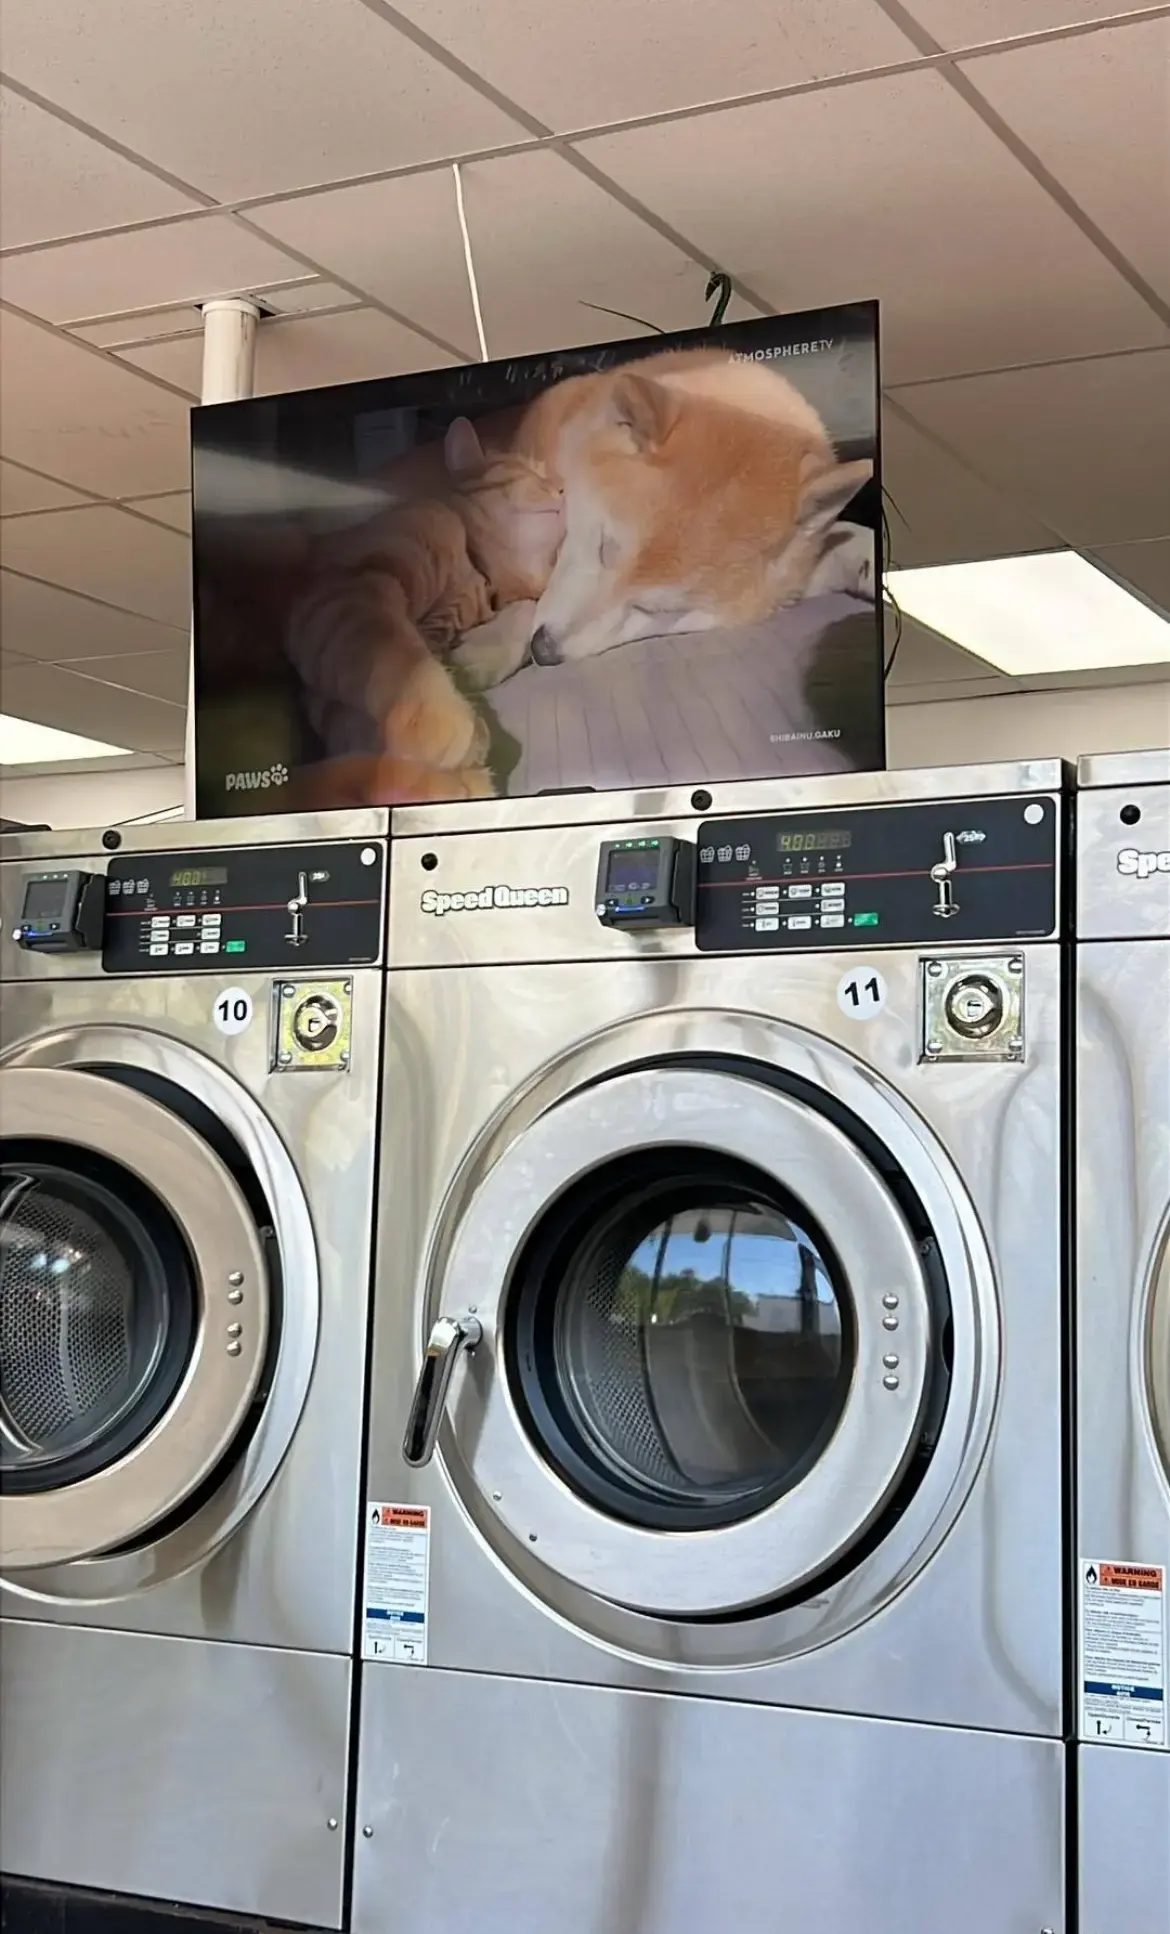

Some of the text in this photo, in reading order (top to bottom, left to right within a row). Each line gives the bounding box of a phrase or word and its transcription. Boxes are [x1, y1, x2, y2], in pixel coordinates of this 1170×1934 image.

[225, 770, 271, 791] PAWS
[845, 977, 880, 1006] 11
[218, 999, 248, 1021] 10
[1113, 1566, 1157, 1578] WARNING
